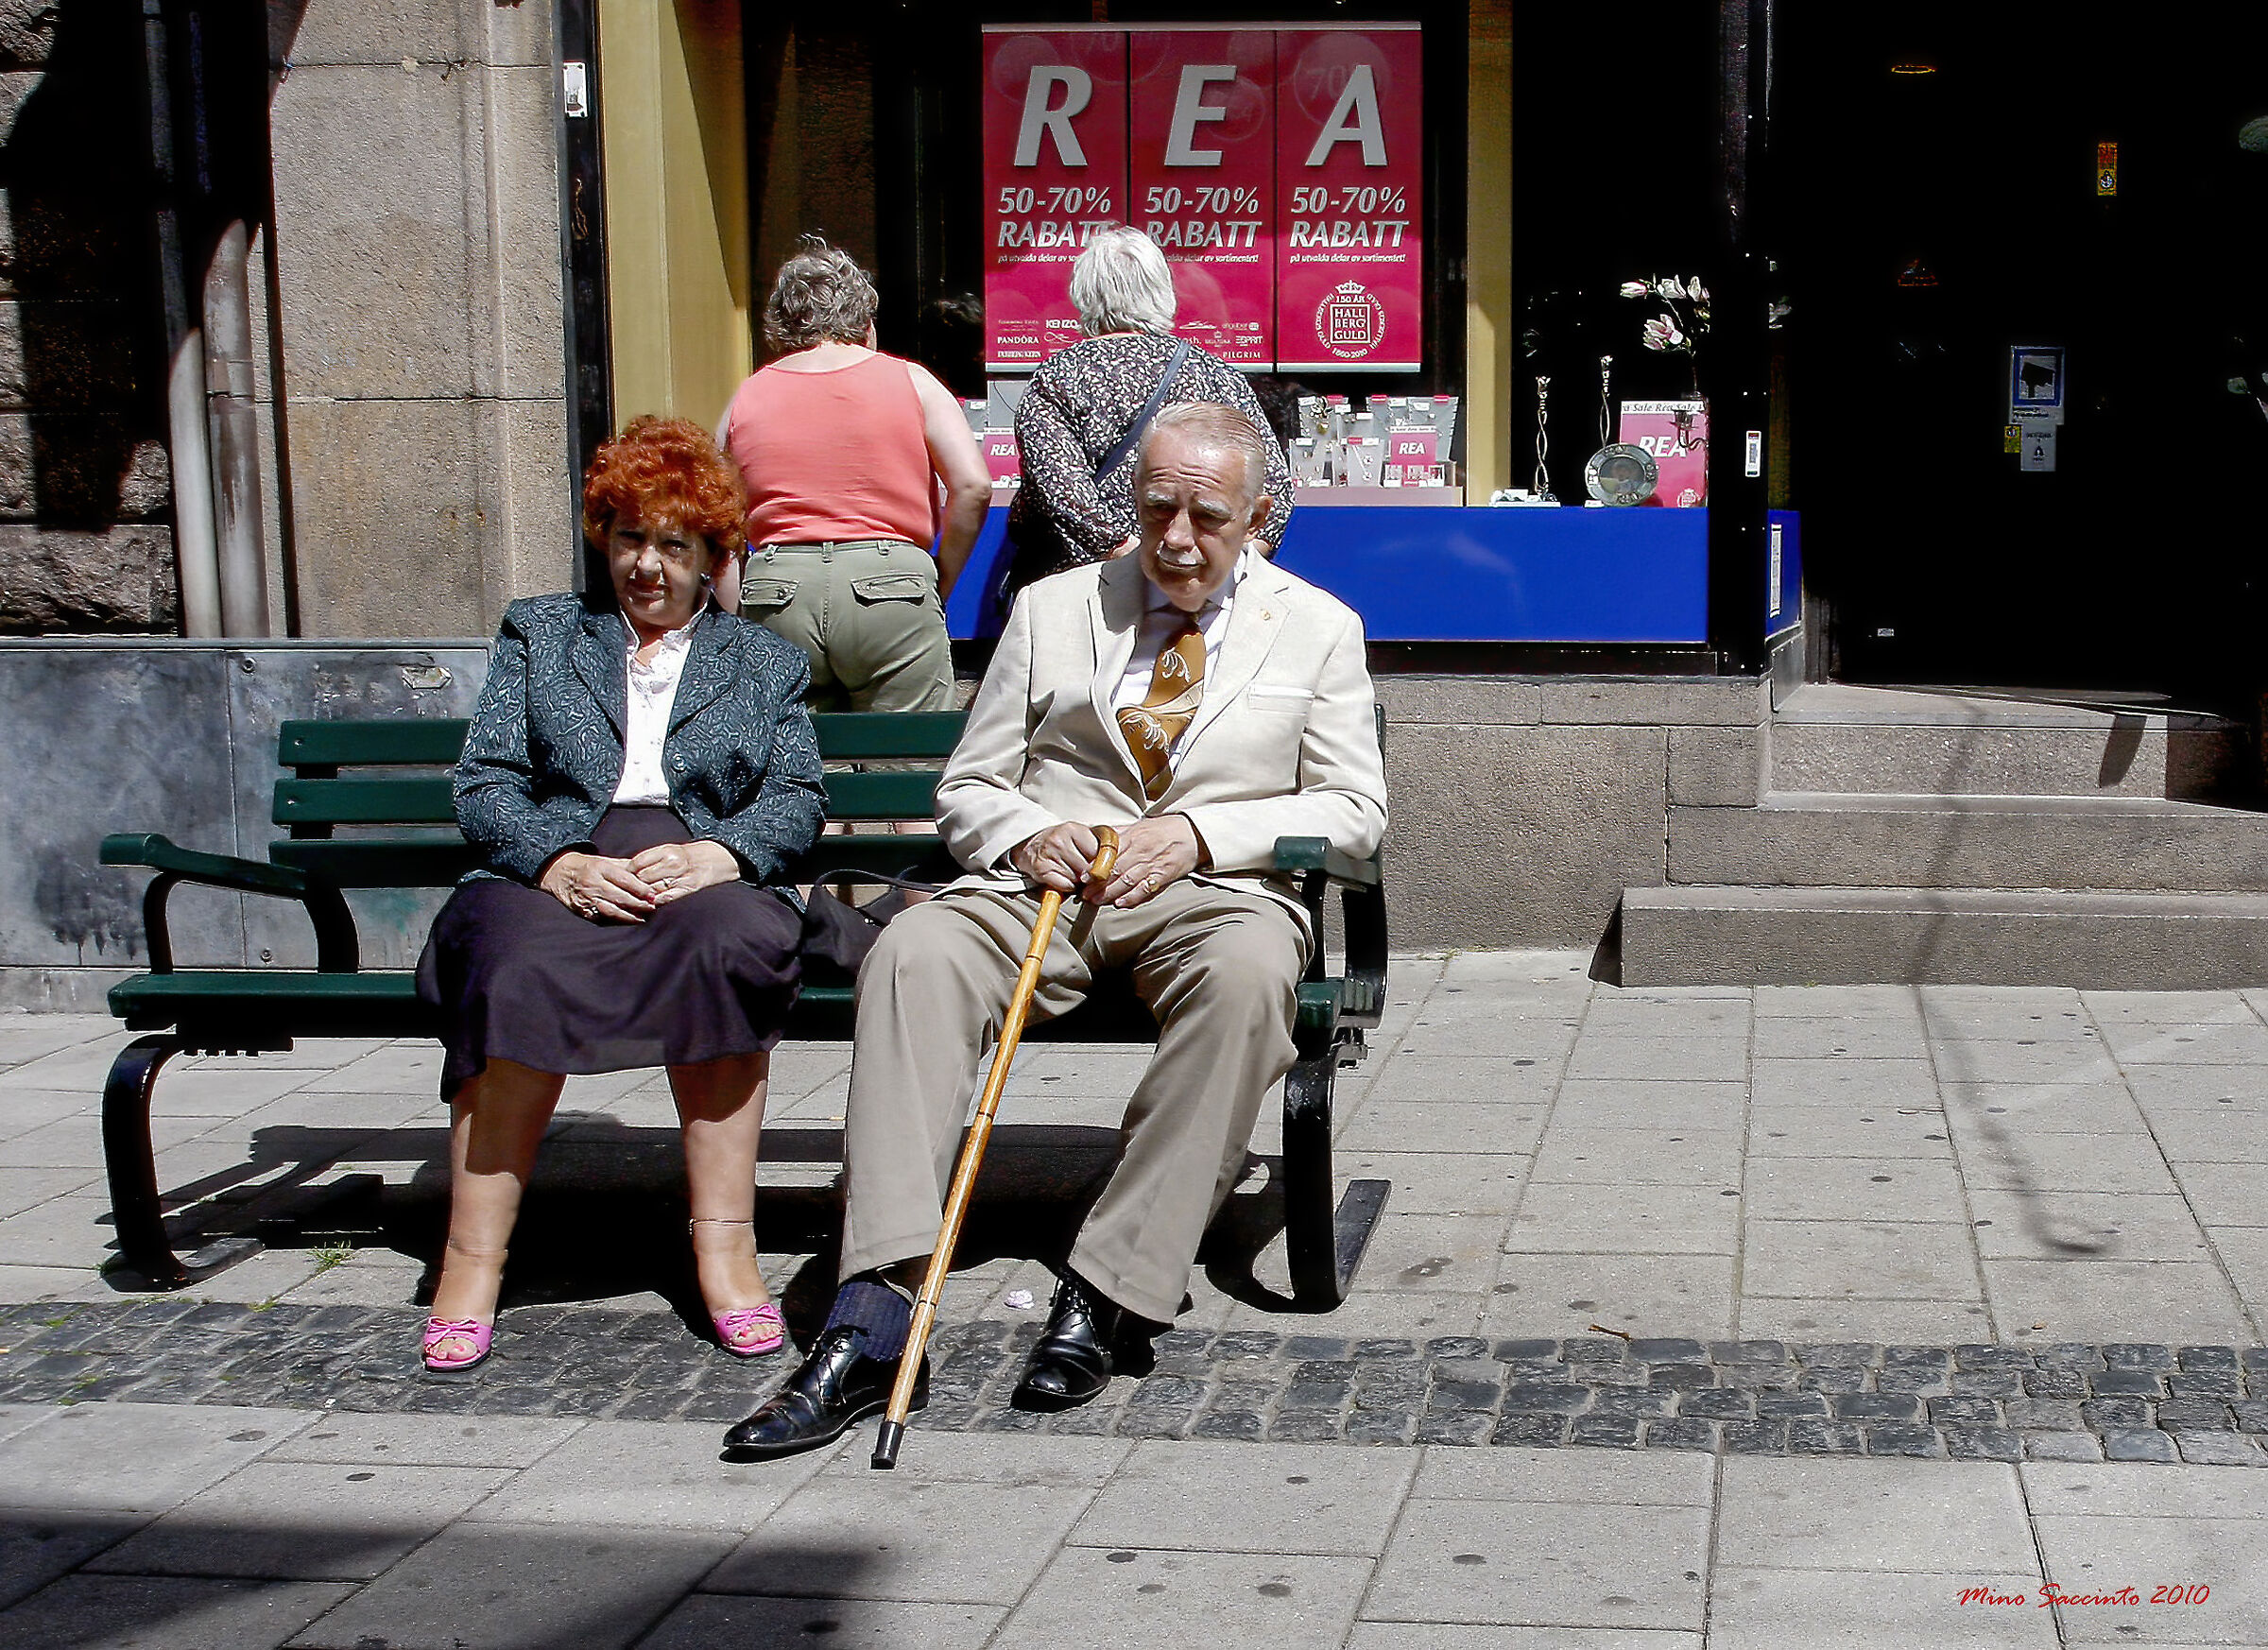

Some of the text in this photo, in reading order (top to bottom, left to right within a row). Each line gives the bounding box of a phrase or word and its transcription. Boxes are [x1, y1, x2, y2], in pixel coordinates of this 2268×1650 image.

[998, 187, 1111, 214] 50-70%
[1144, 186, 1259, 214] 50-70%
[1290, 186, 1405, 214] 50-70%
[1146, 220, 1263, 248] RABATT
[1289, 220, 1409, 248] RABATT
[1331, 253, 1349, 263] delar
[1350, 254, 1361, 263] av
[1334, 308, 1366, 318] HALL
[1045, 319, 1078, 329] KENZO
[1334, 318, 1366, 328] BERG
[1333, 330, 1366, 339] GULD
[1222, 351, 1261, 359] PILGRIM
[1634, 404, 1653, 412] Sale
[1655, 404, 1672, 412] Rea
[990, 444, 1016, 455] REA
[1399, 442, 1425, 455] REA
[1638, 436, 1687, 457] REA
